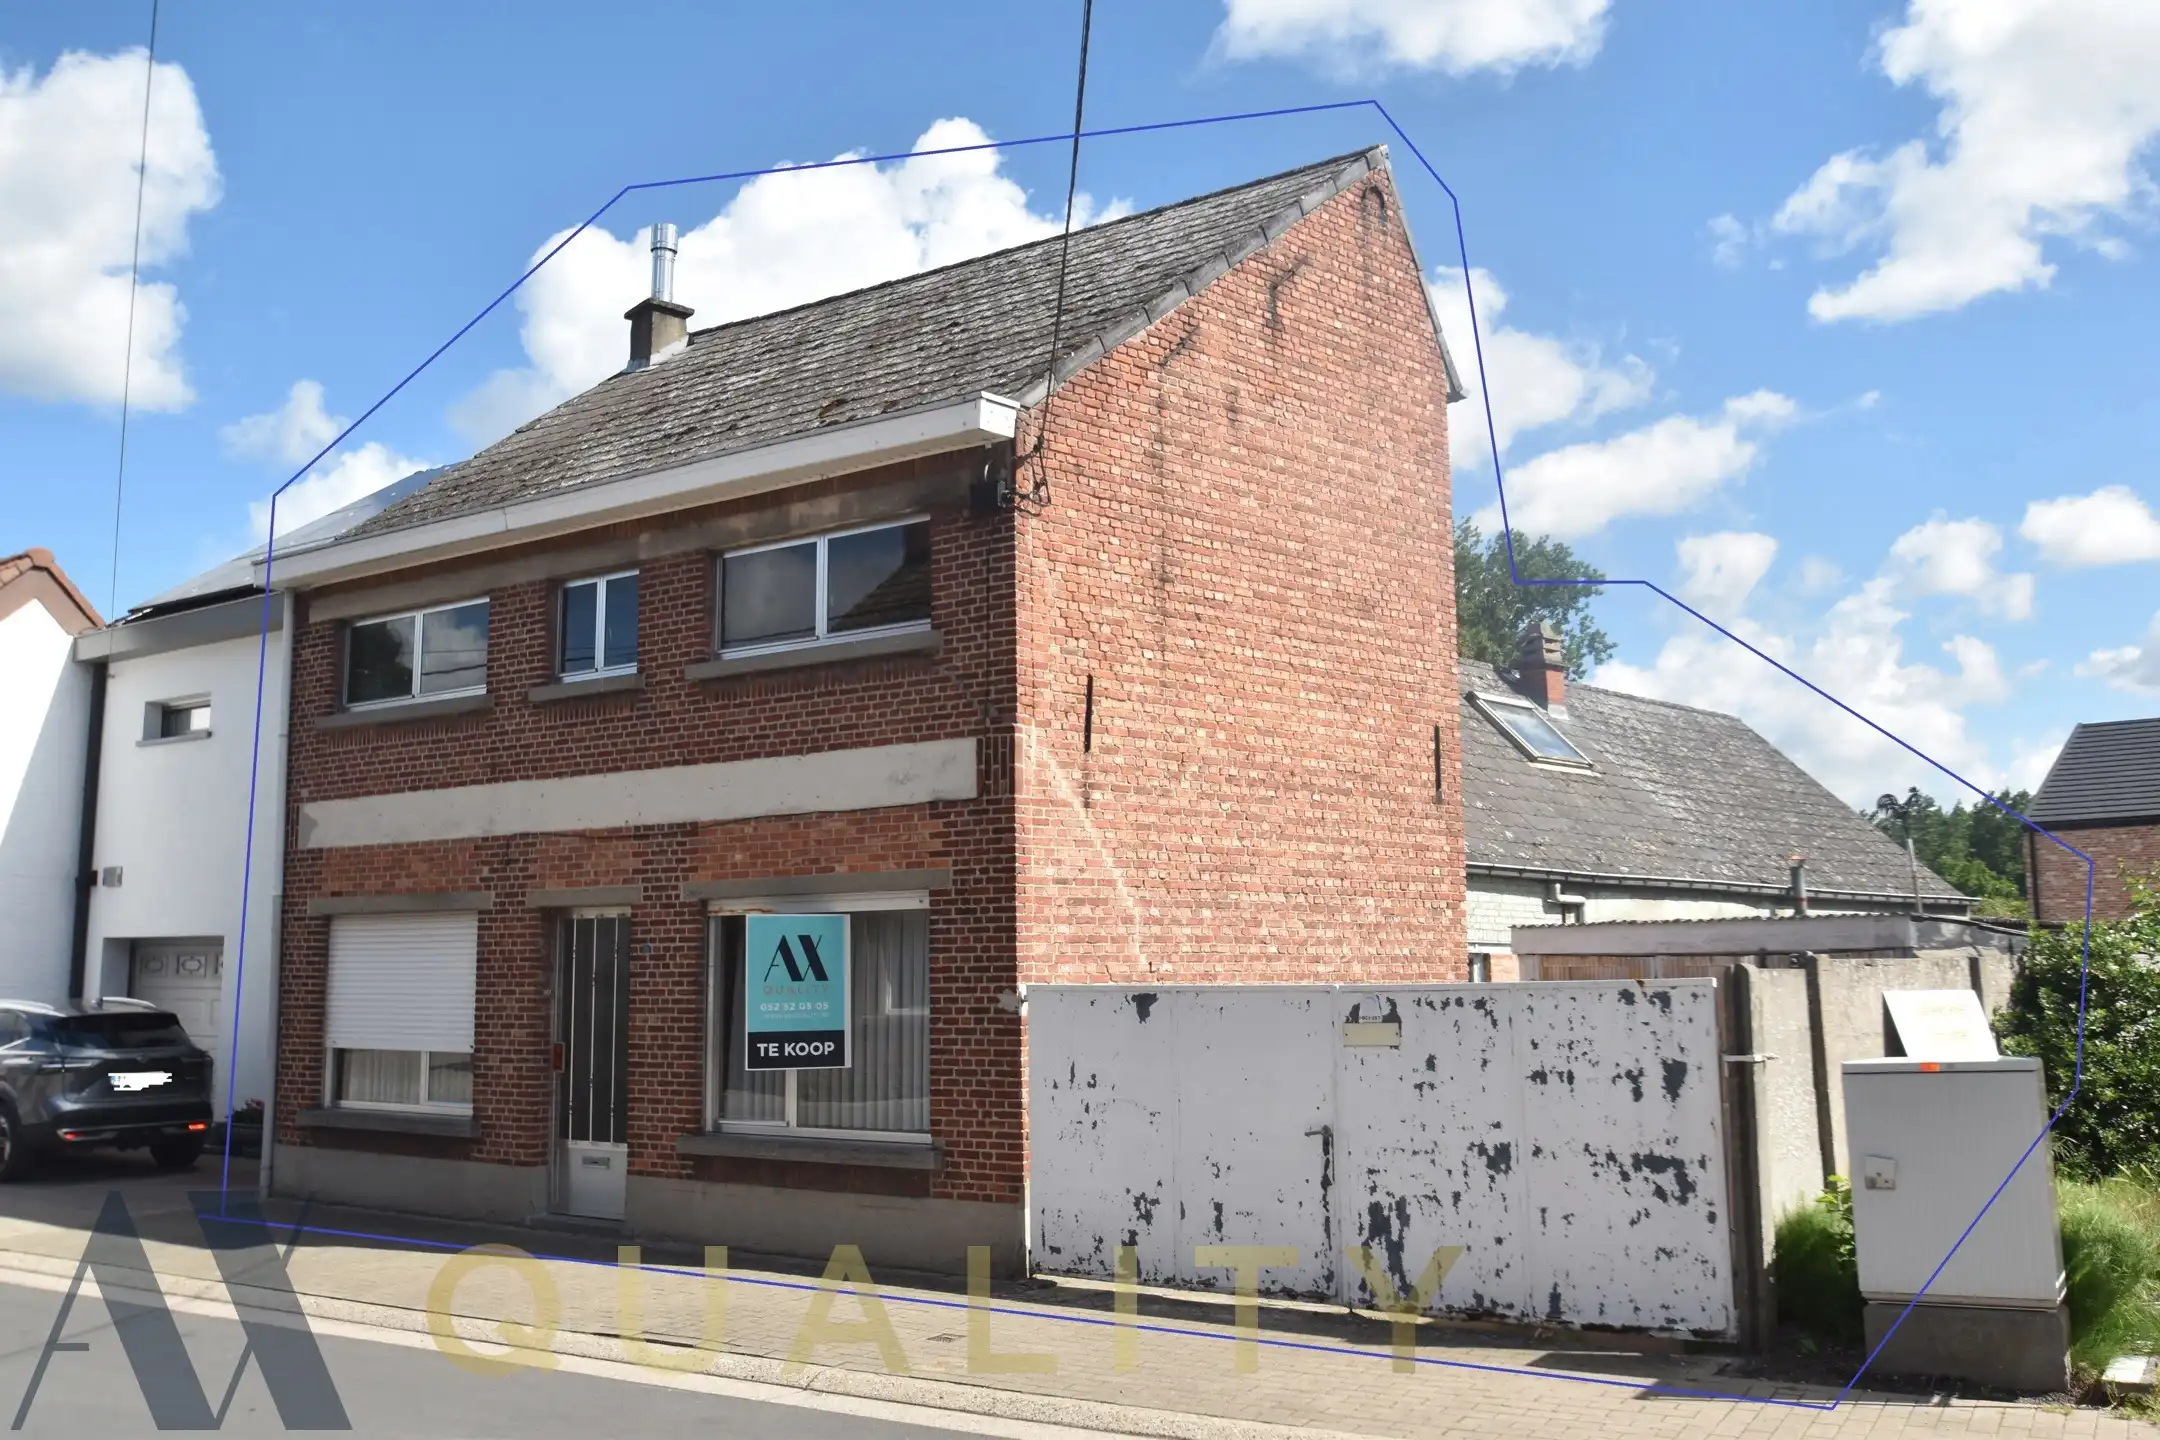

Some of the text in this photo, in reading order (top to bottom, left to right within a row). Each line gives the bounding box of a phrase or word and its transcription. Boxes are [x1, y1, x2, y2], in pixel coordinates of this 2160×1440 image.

[764, 984, 830, 995] QUALITY
[760, 1002, 780, 1011] 052
[783, 1002, 797, 1011] 52
[815, 1001, 829, 1010] 05
[757, 1042, 835, 1056] TE KOOP
